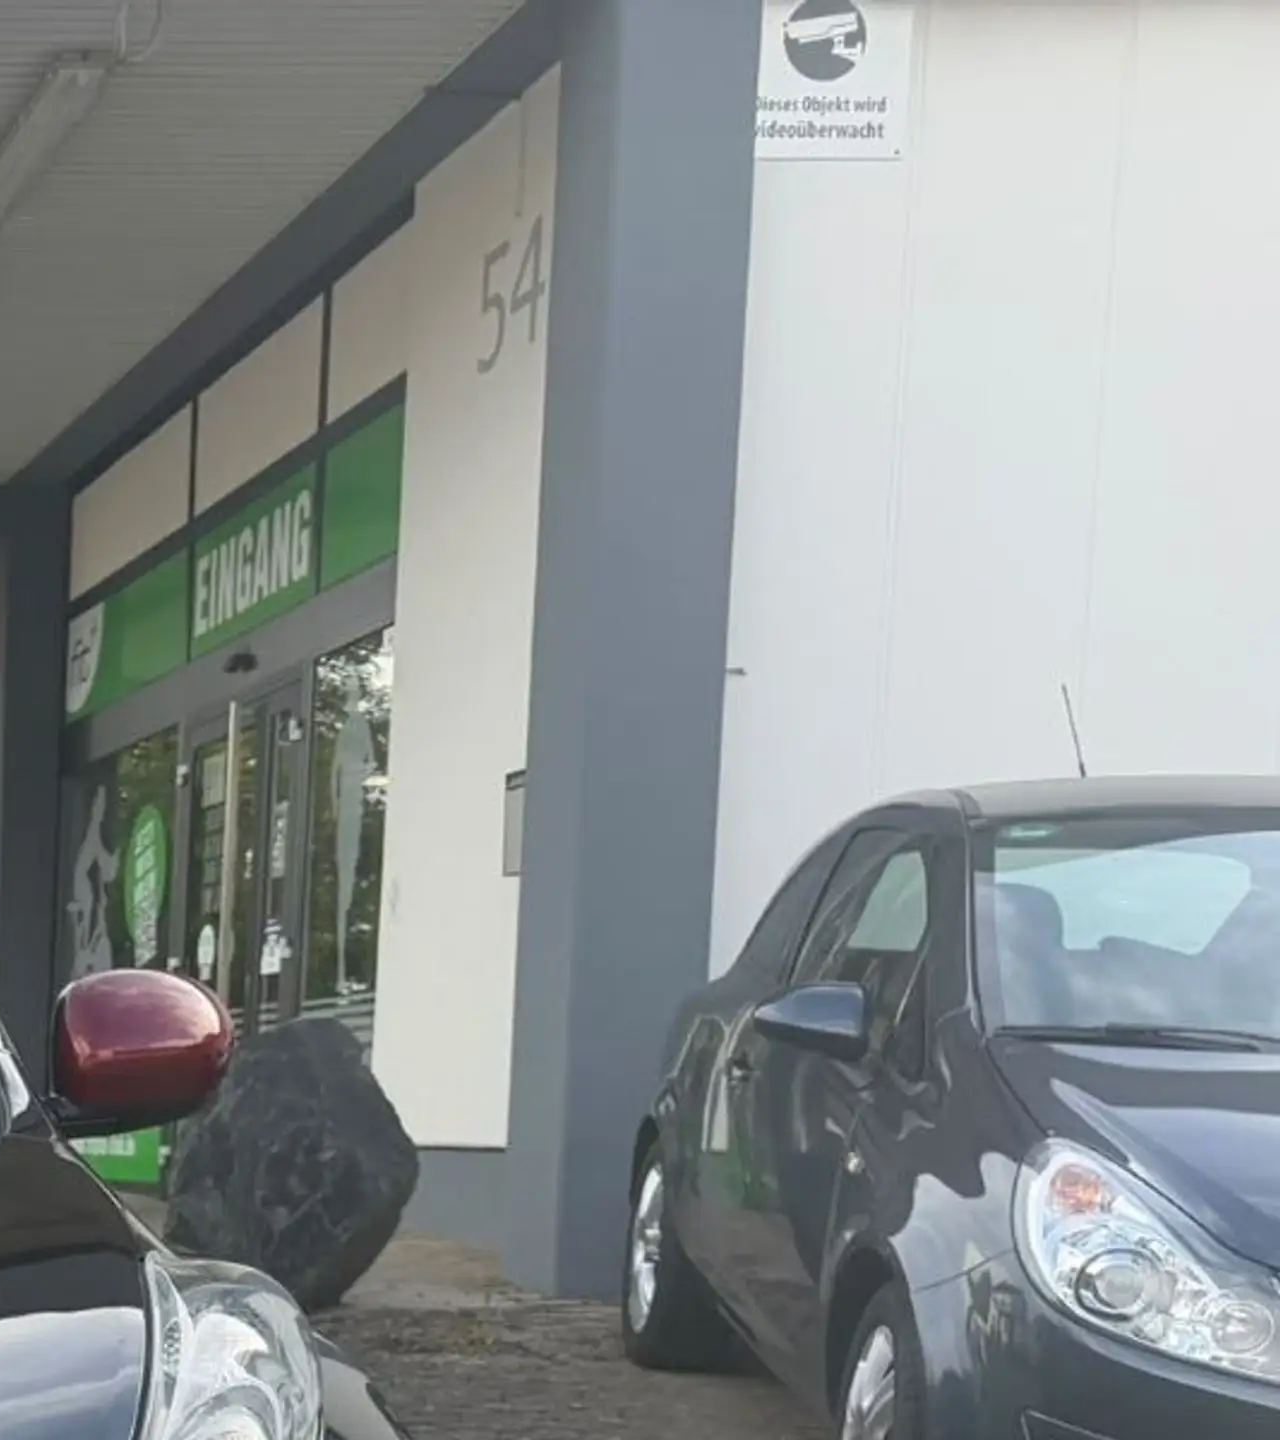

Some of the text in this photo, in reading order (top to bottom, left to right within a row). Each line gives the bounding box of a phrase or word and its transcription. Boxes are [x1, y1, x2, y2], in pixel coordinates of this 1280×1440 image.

[802, 96, 850, 116] Objekt
[853, 96, 888, 113] wird
[476, 212, 546, 374] 54
[193, 489, 312, 639] EINGANG
